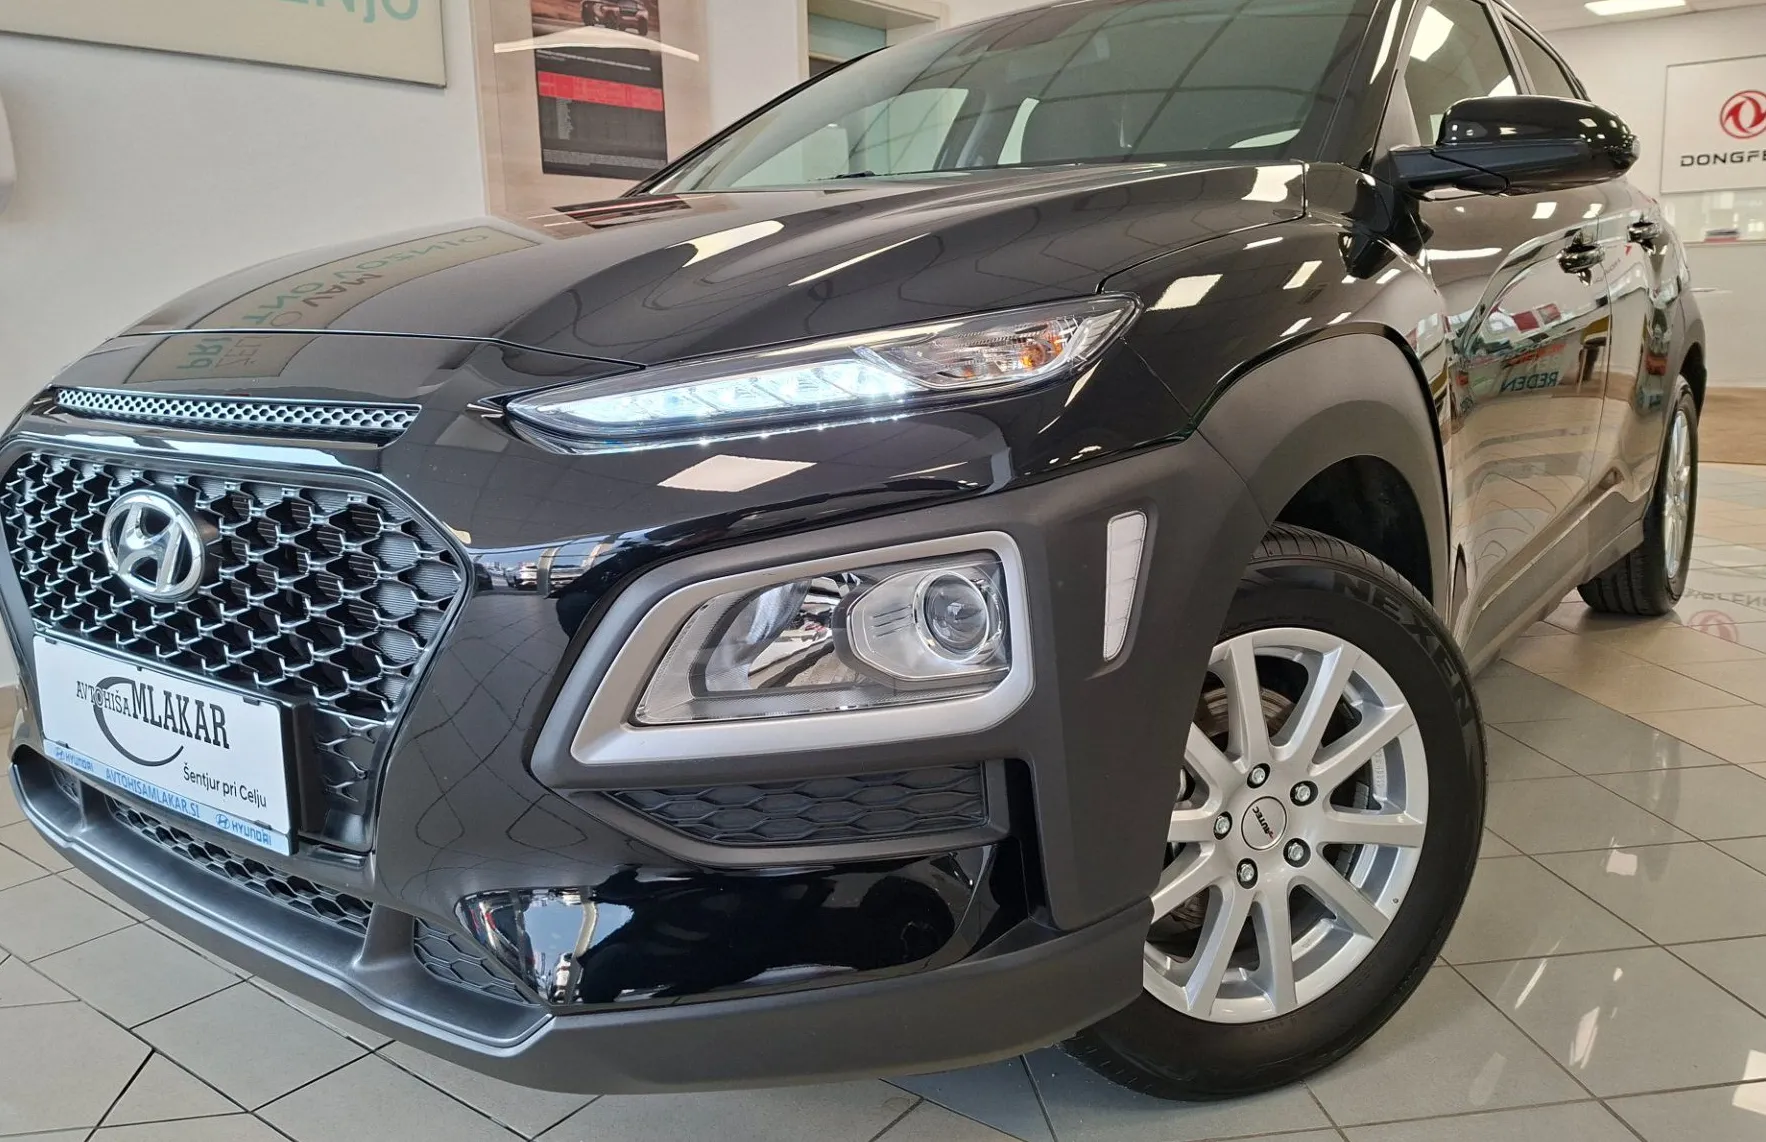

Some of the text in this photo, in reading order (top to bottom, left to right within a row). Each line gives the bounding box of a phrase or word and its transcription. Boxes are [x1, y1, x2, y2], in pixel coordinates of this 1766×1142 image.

[1680, 149, 1766, 167] DONGF
[75, 680, 230, 750] AVTOHIŠA MLAKAR
[105, 767, 201, 818] AVTOHISAMLAKAR.SI
[183, 762, 267, 809] Šentjur pri Celju
[231, 821, 272, 846] HYUNDAI
